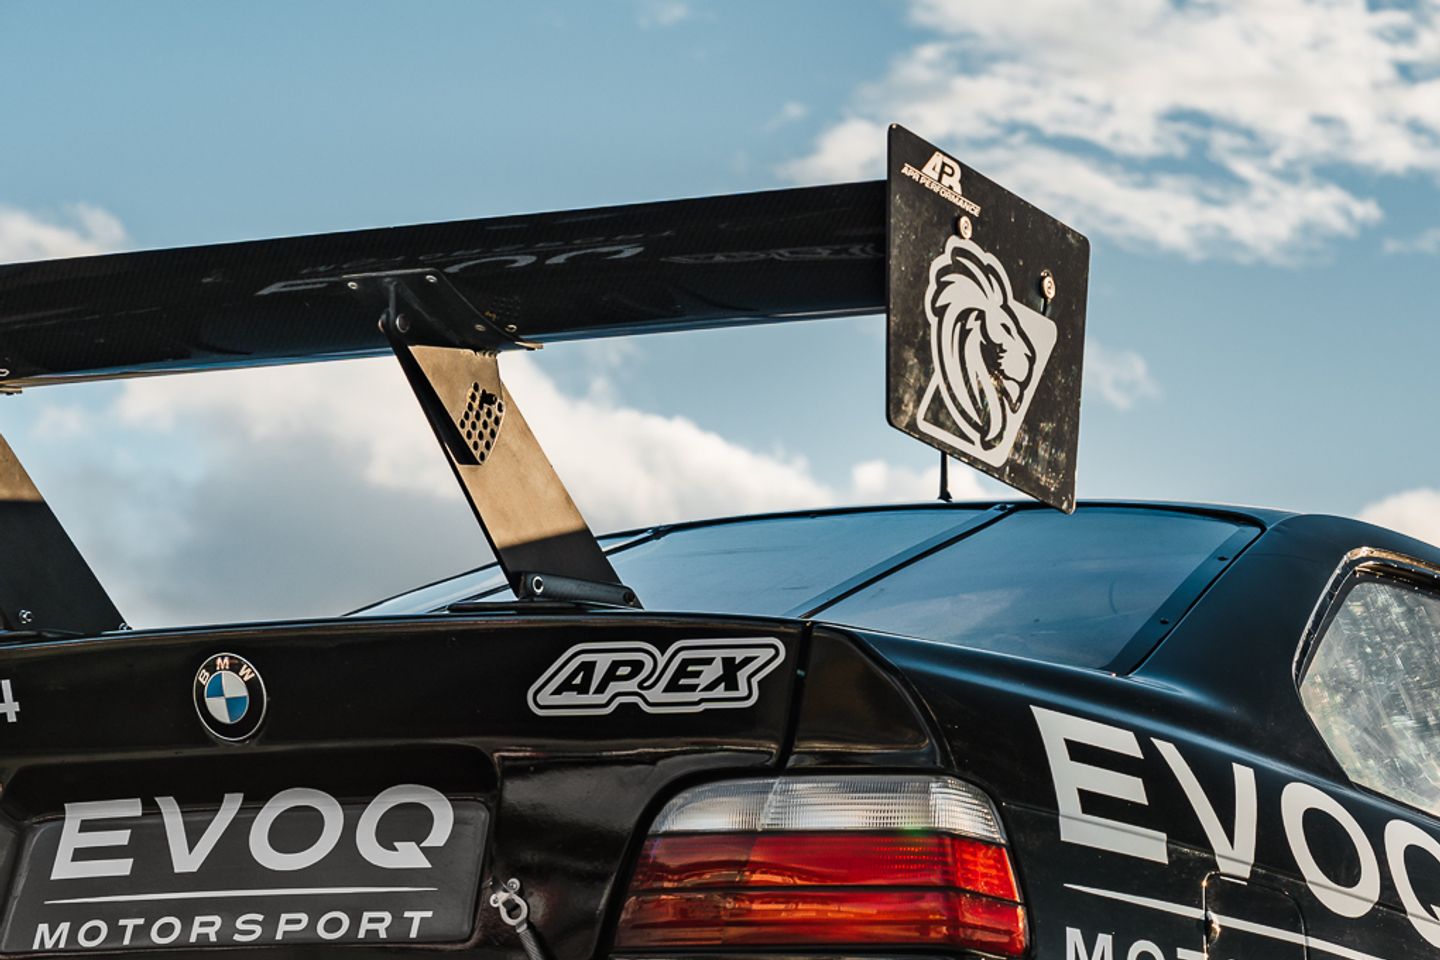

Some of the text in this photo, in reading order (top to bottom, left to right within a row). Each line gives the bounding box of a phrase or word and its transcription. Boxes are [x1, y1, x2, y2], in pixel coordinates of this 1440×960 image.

[198, 656, 255, 686] BMW
[549, 655, 760, 696] APEX
[50, 784, 454, 880] EVOQ
[32, 911, 434, 950] MOTORSPORT
